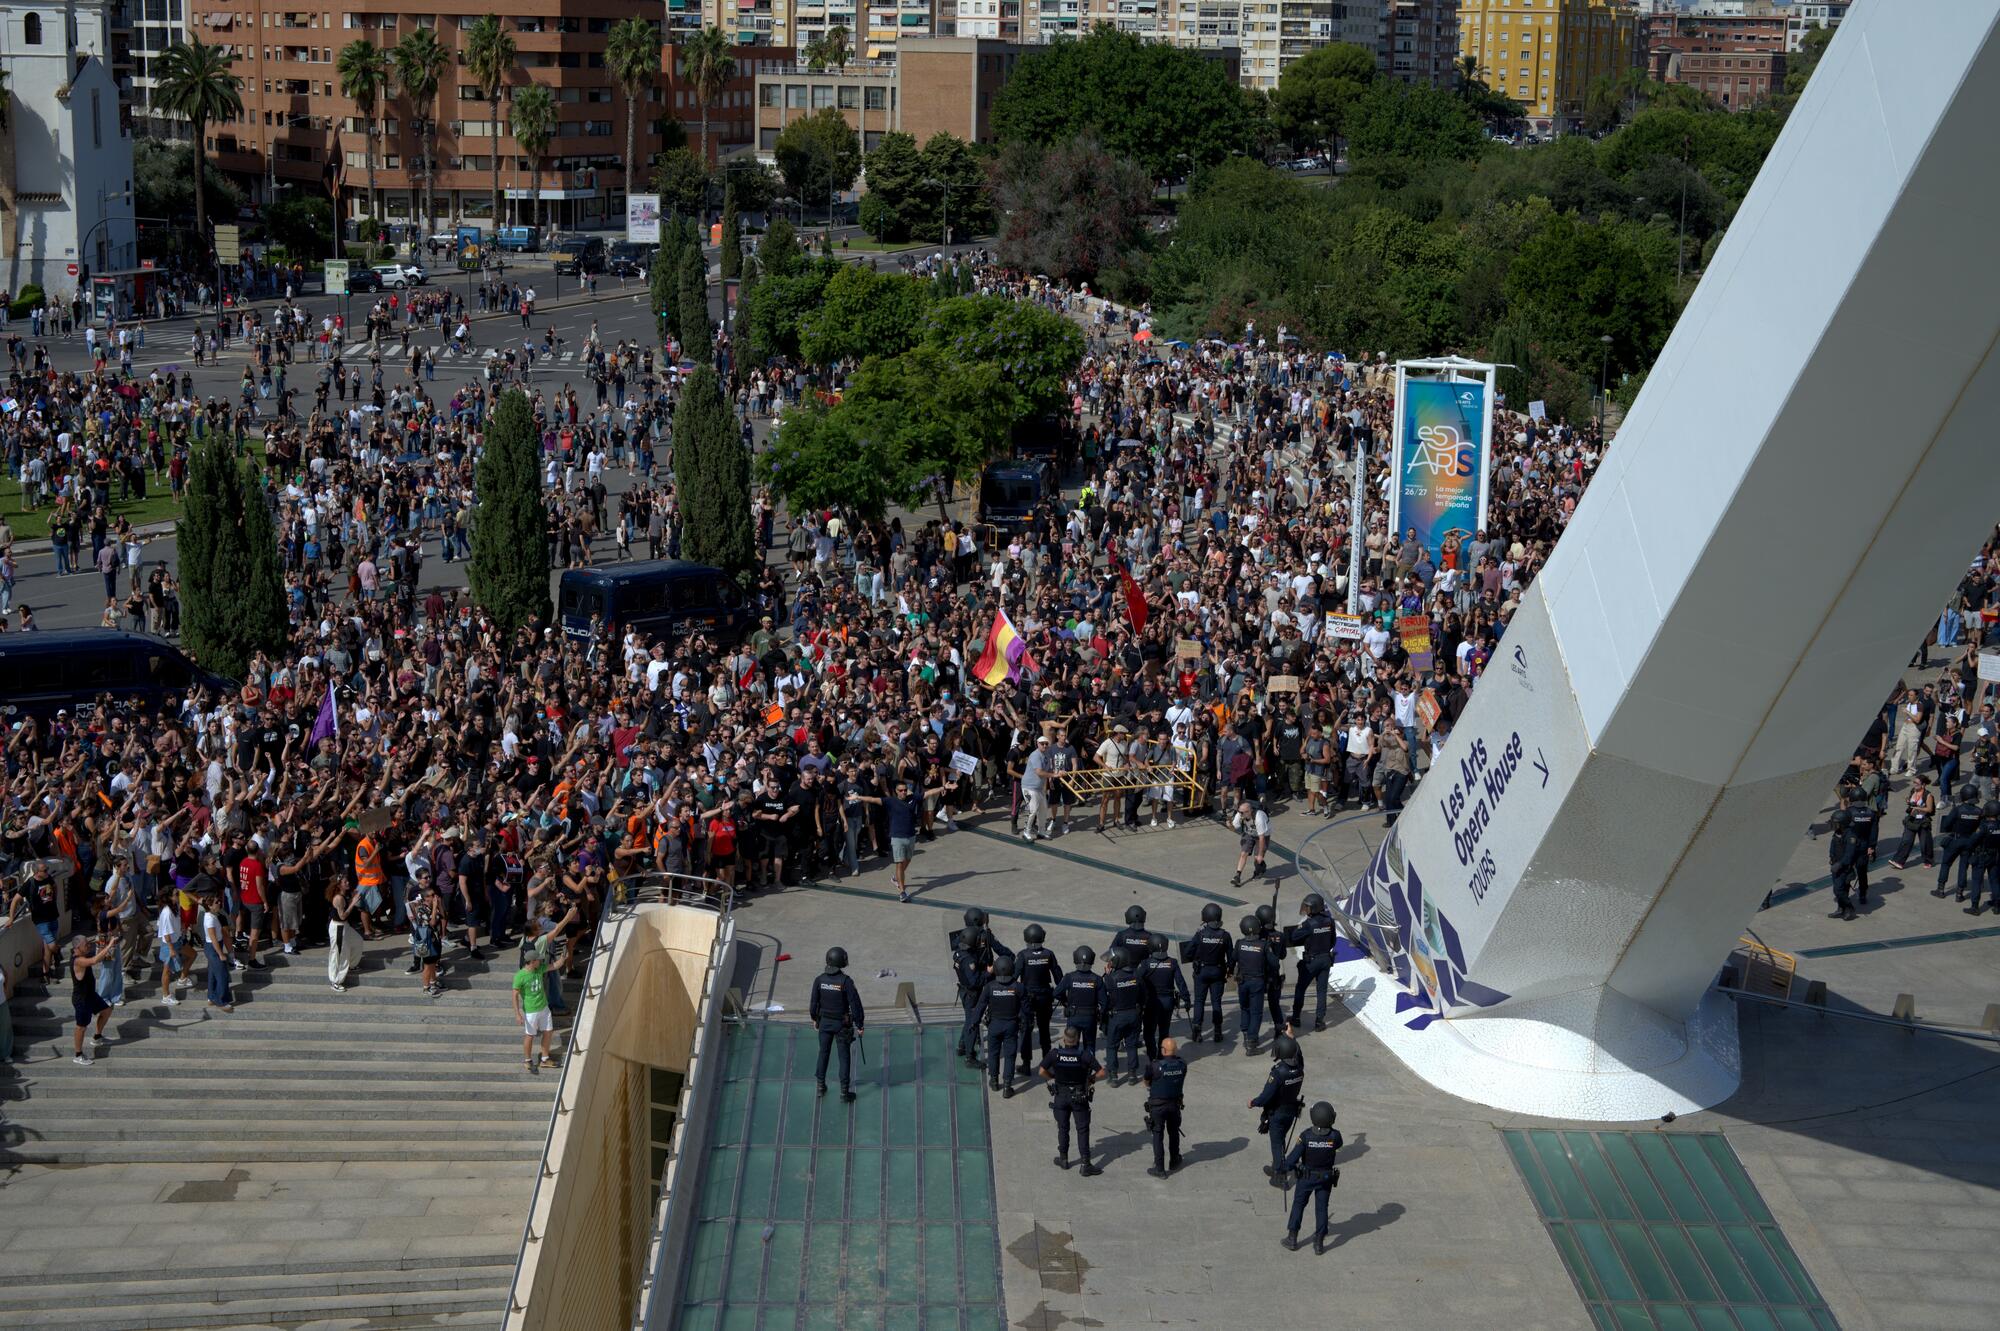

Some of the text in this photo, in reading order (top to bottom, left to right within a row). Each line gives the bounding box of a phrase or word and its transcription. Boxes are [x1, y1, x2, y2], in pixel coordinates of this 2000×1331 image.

[1405, 488, 1427, 496] 26/27
[1446, 487, 1465, 495] mejor
[1435, 493, 1472, 502] temporada
[1404, 636, 1430, 648] DIGNE
[1440, 737, 1488, 832] Les Arts
[1454, 731, 1523, 867] Opera House
[1468, 848, 1497, 906] TOURS
